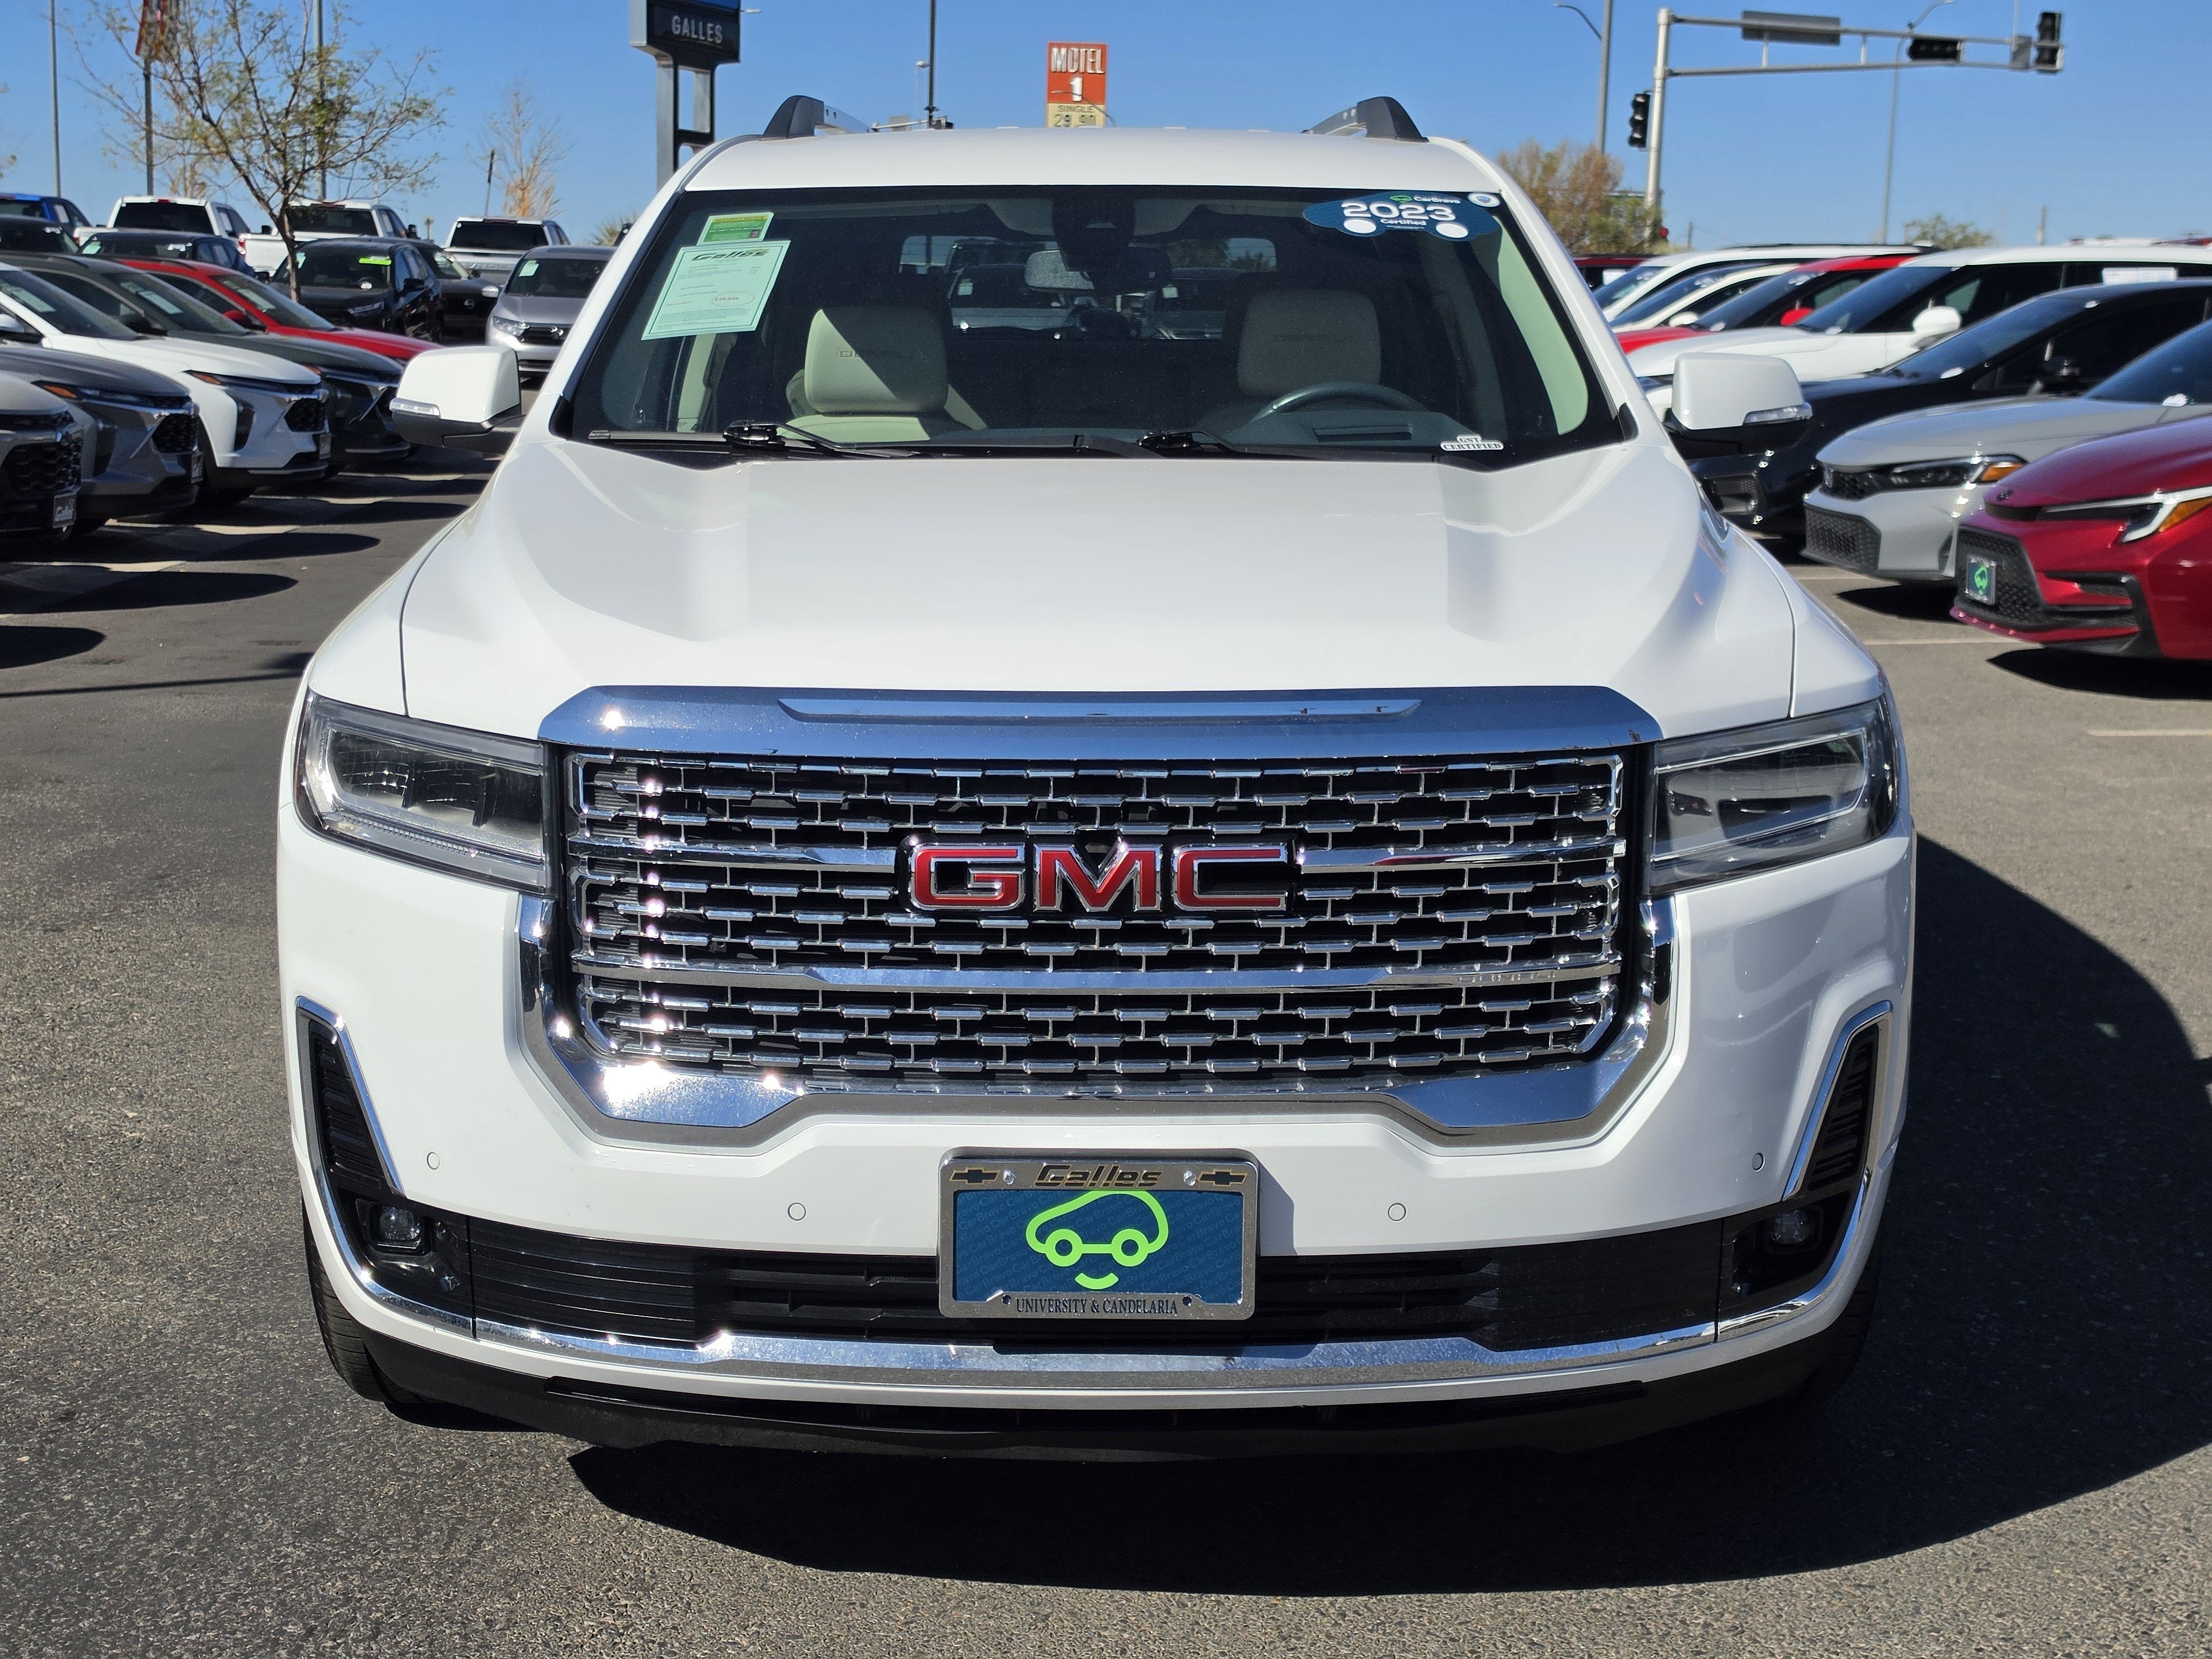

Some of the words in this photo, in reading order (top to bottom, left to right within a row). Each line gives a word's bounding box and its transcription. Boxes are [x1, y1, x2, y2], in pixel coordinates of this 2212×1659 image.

[671, 15, 723, 44] GALLES
[1051, 48, 1105, 74] MOTEL
[1070, 77, 1082, 102] 1
[1341, 202, 1456, 221] 2023
[909, 842, 1287, 912] GMC
[1034, 1164, 1162, 1188] Galles
[1015, 1298, 1087, 1313] UNIVERSITY
[1091, 1298, 1100, 1313] &
[1103, 1298, 1178, 1314] CANDELARIA
